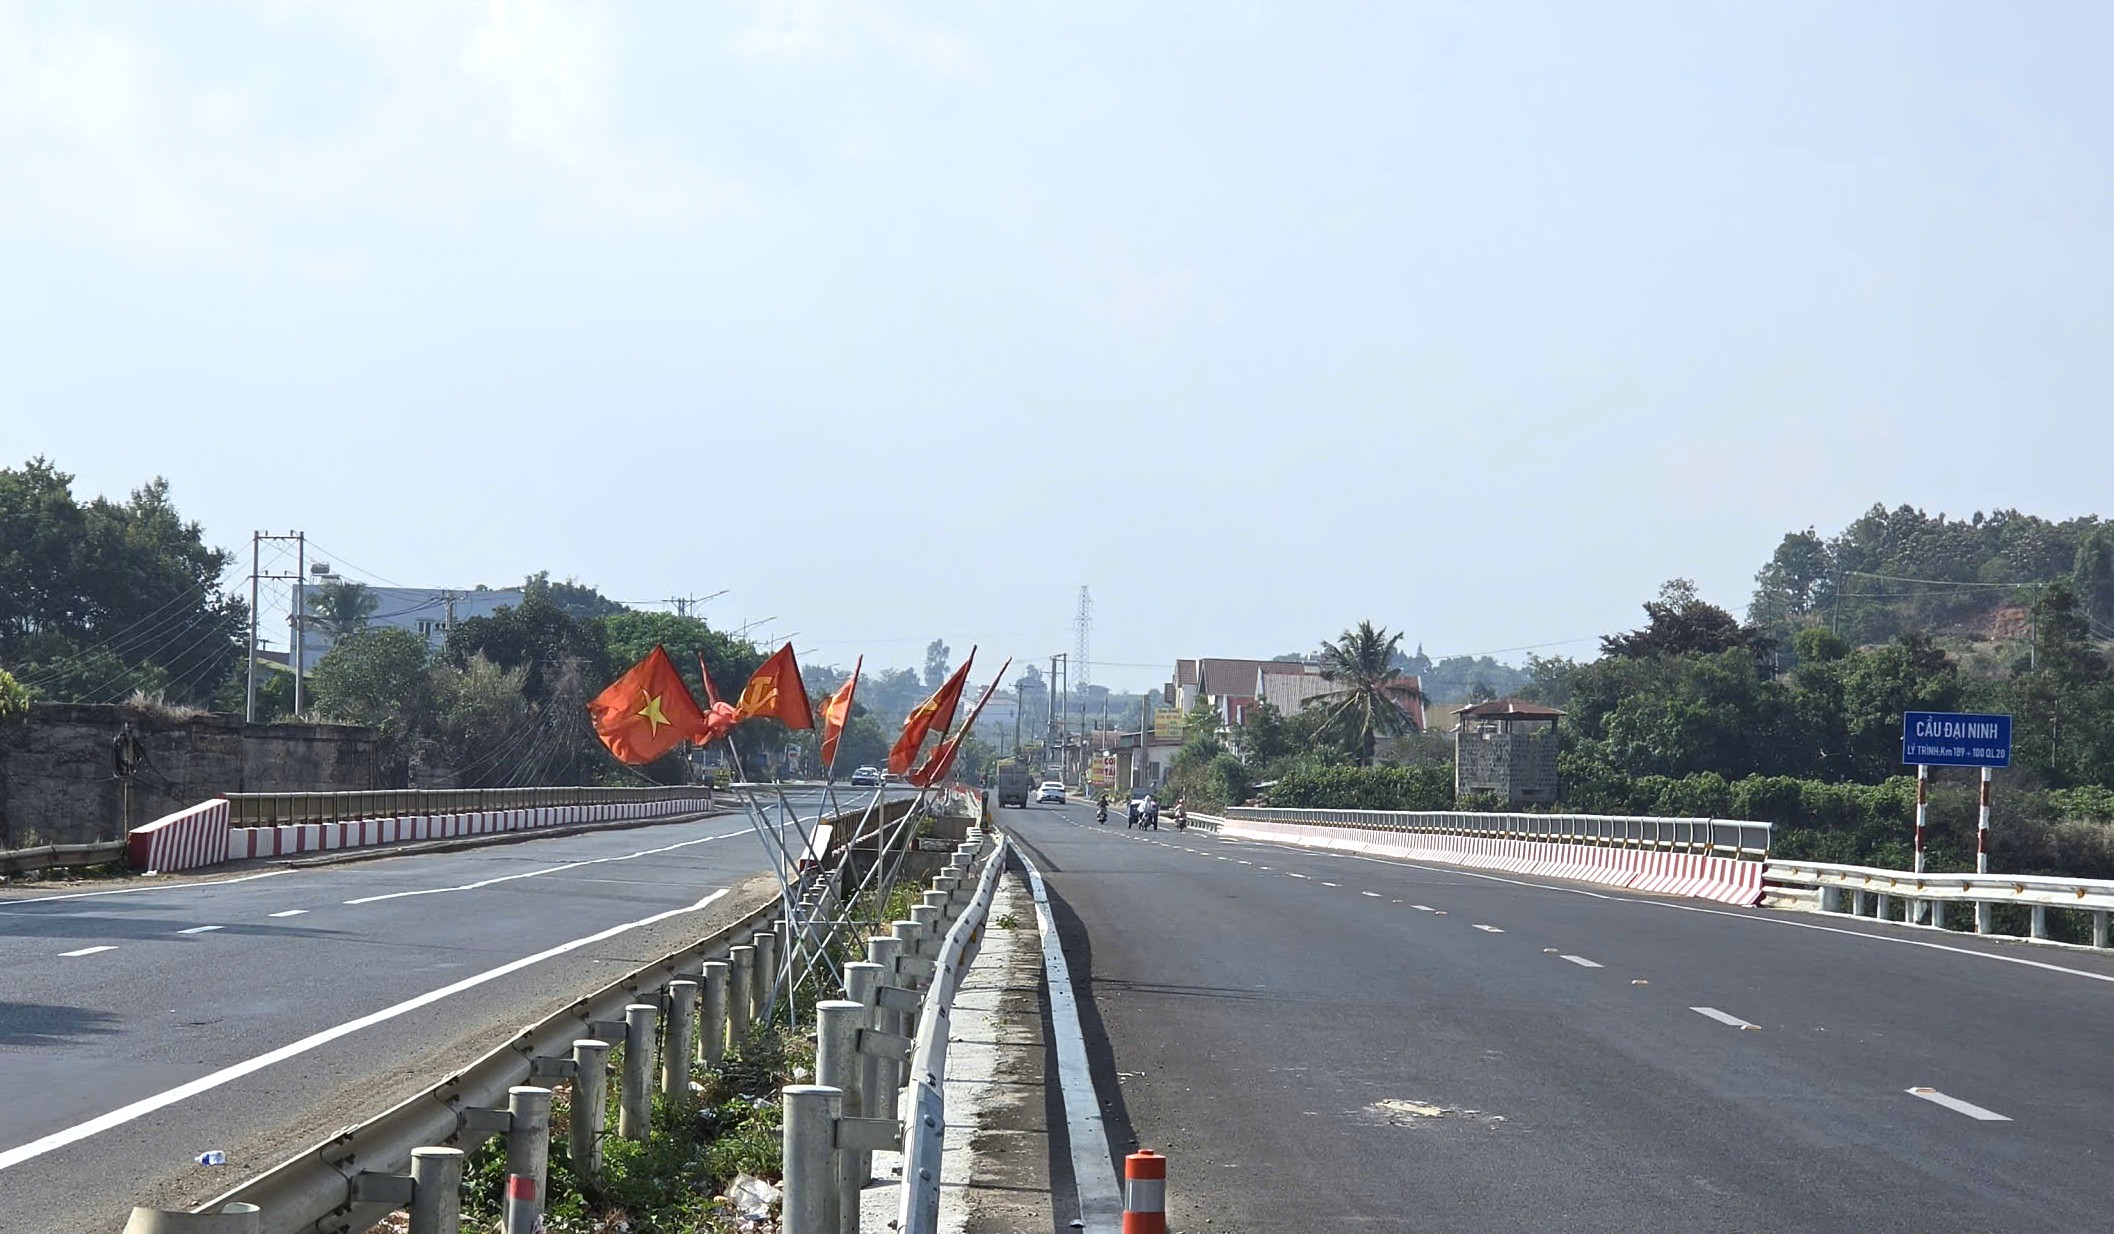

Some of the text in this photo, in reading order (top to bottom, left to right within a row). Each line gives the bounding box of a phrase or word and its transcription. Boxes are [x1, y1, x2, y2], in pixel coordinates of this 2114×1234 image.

[1916, 715, 1998, 740] CẦU ĐẠI NINH
